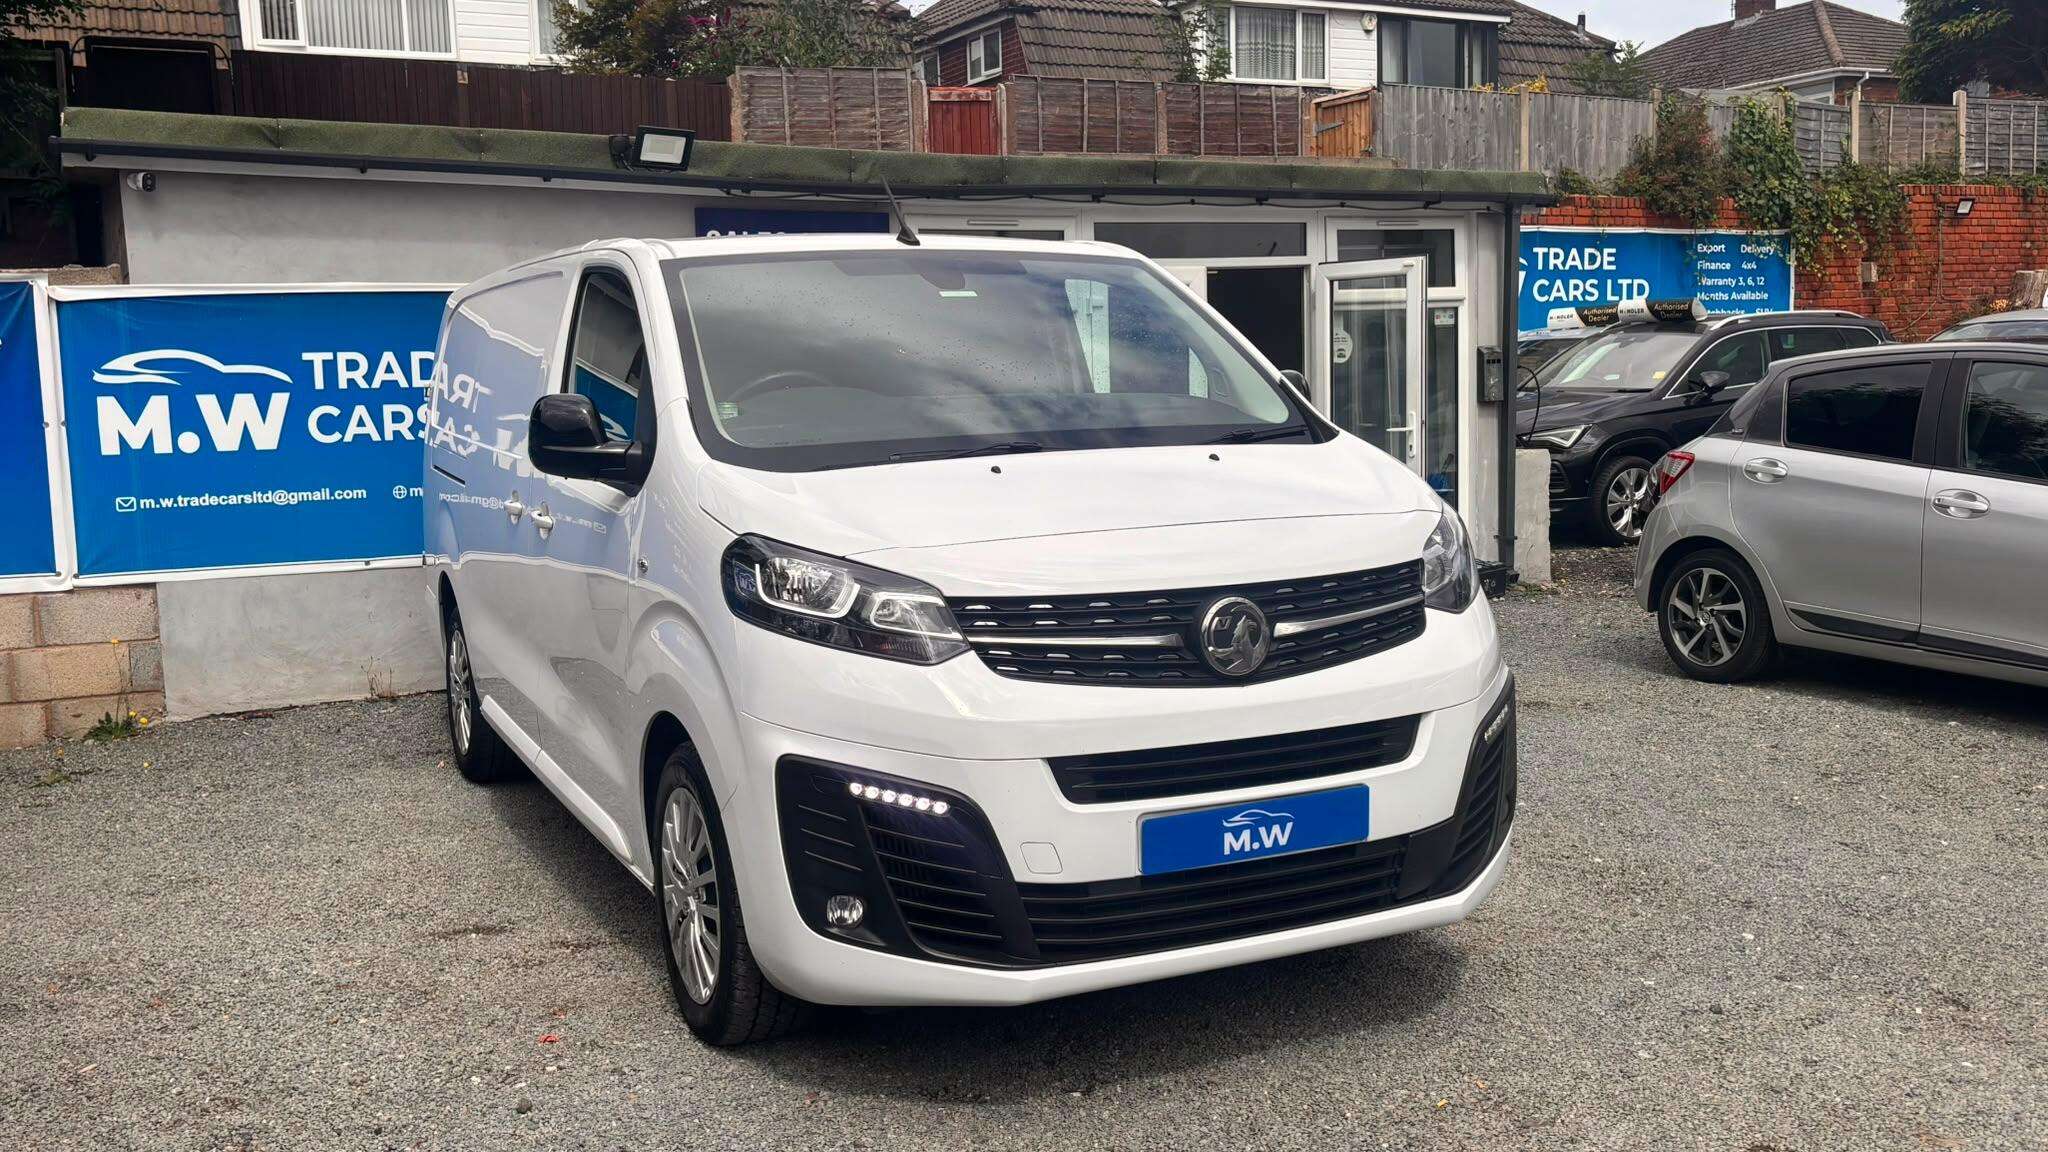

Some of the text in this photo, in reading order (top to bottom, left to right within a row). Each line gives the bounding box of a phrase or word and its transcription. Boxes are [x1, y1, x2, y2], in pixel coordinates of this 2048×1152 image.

[1697, 244, 1775, 255] Export Delivery
[1532, 247, 1617, 271] TRADE
[1697, 260, 1757, 270] Finance 4x4
[1738, 277, 1746, 286] 3,
[1747, 277, 1755, 286] 6,
[1756, 277, 1765, 285] 12
[1532, 278, 1600, 302] CARS
[1606, 278, 1650, 301] LTD
[1696, 291, 1769, 300] Months Available
[1582, 307, 1617, 316] Authorised
[1653, 303, 1689, 311] Authorised
[96, 392, 292, 456] M.W
[139, 487, 368, 510] m.w.tradecarsltd@gmail.com
[1224, 822, 1293, 855] M.W
